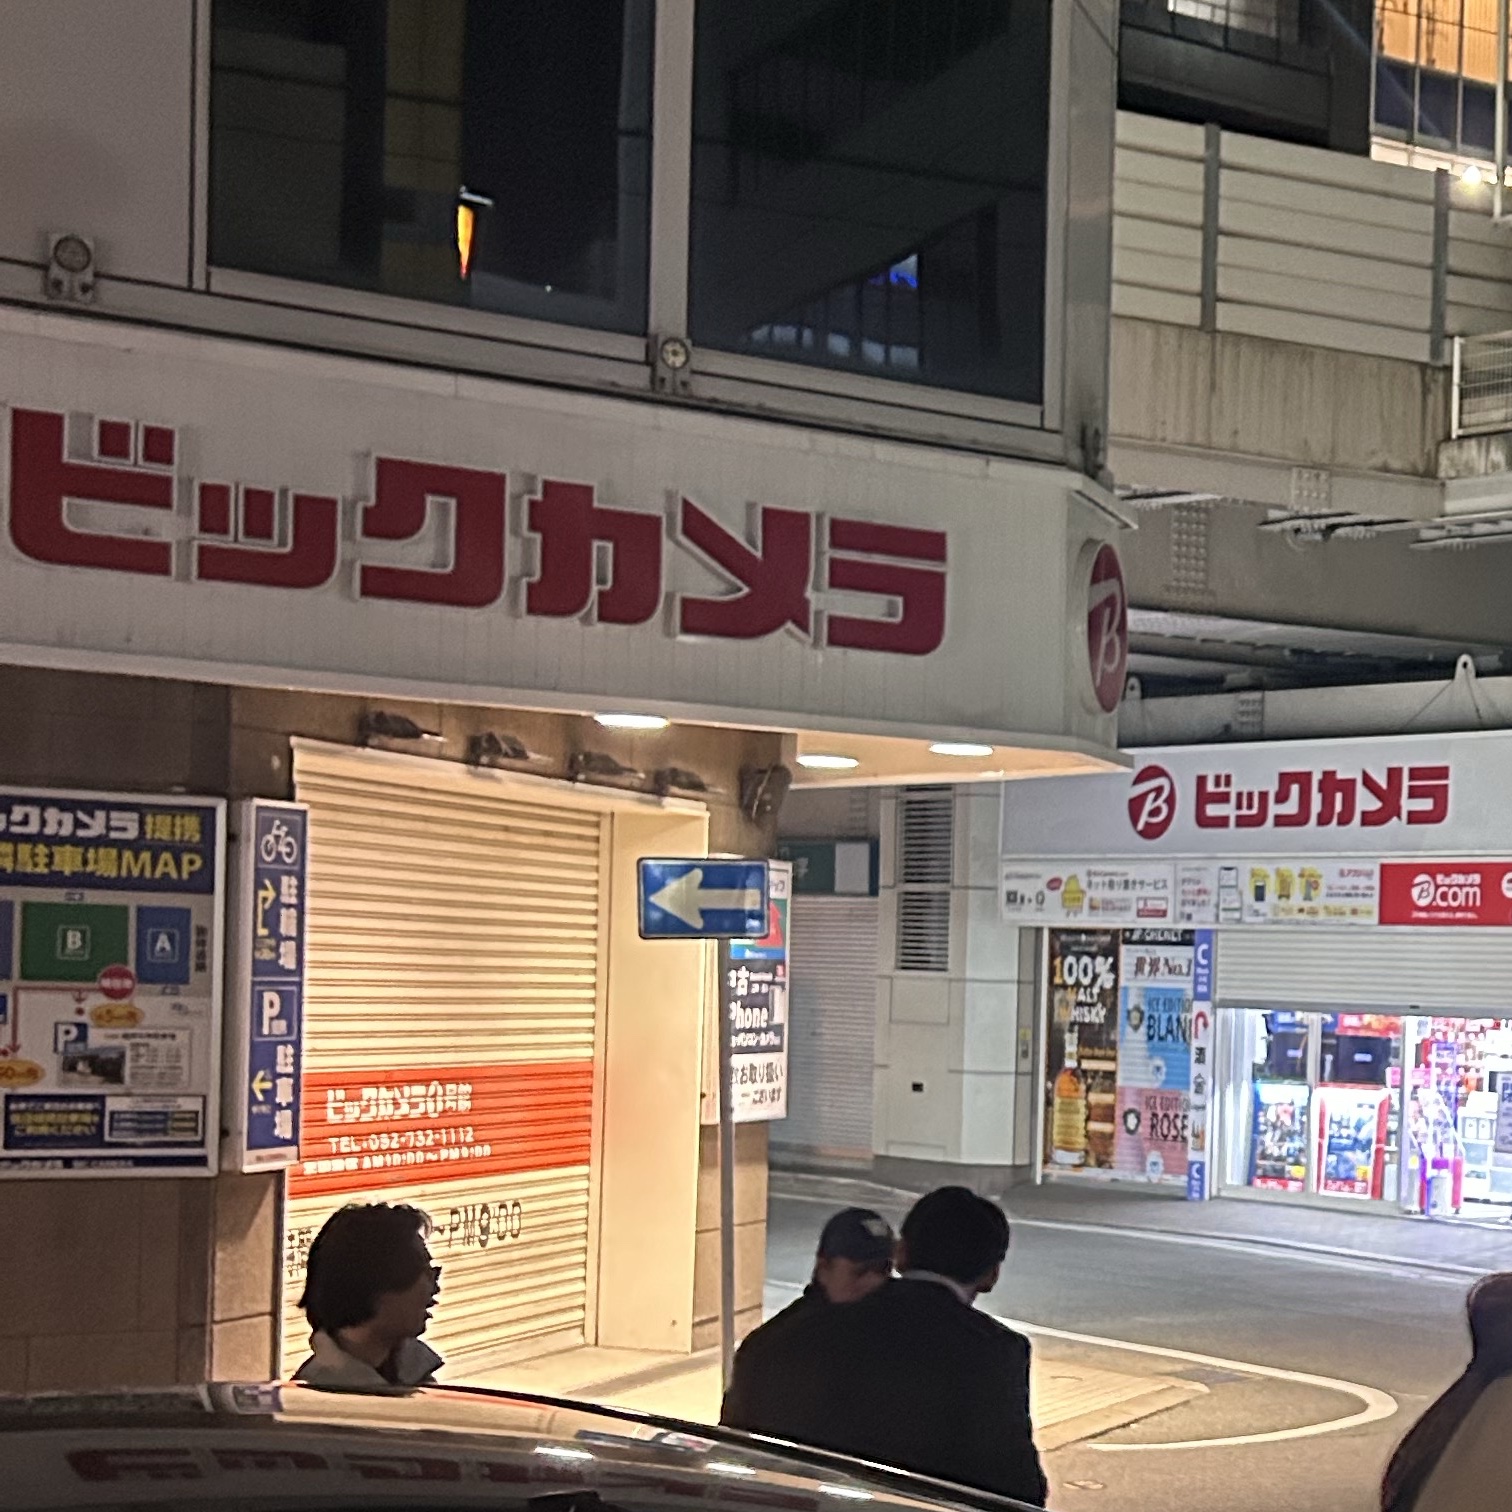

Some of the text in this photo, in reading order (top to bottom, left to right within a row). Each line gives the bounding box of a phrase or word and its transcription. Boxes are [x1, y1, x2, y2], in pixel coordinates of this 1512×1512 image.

[10, 407, 947, 656] ビックカメラ
[1195, 766, 1450, 828] ビックカメラ
[1053, 955, 1116, 989] 100%
